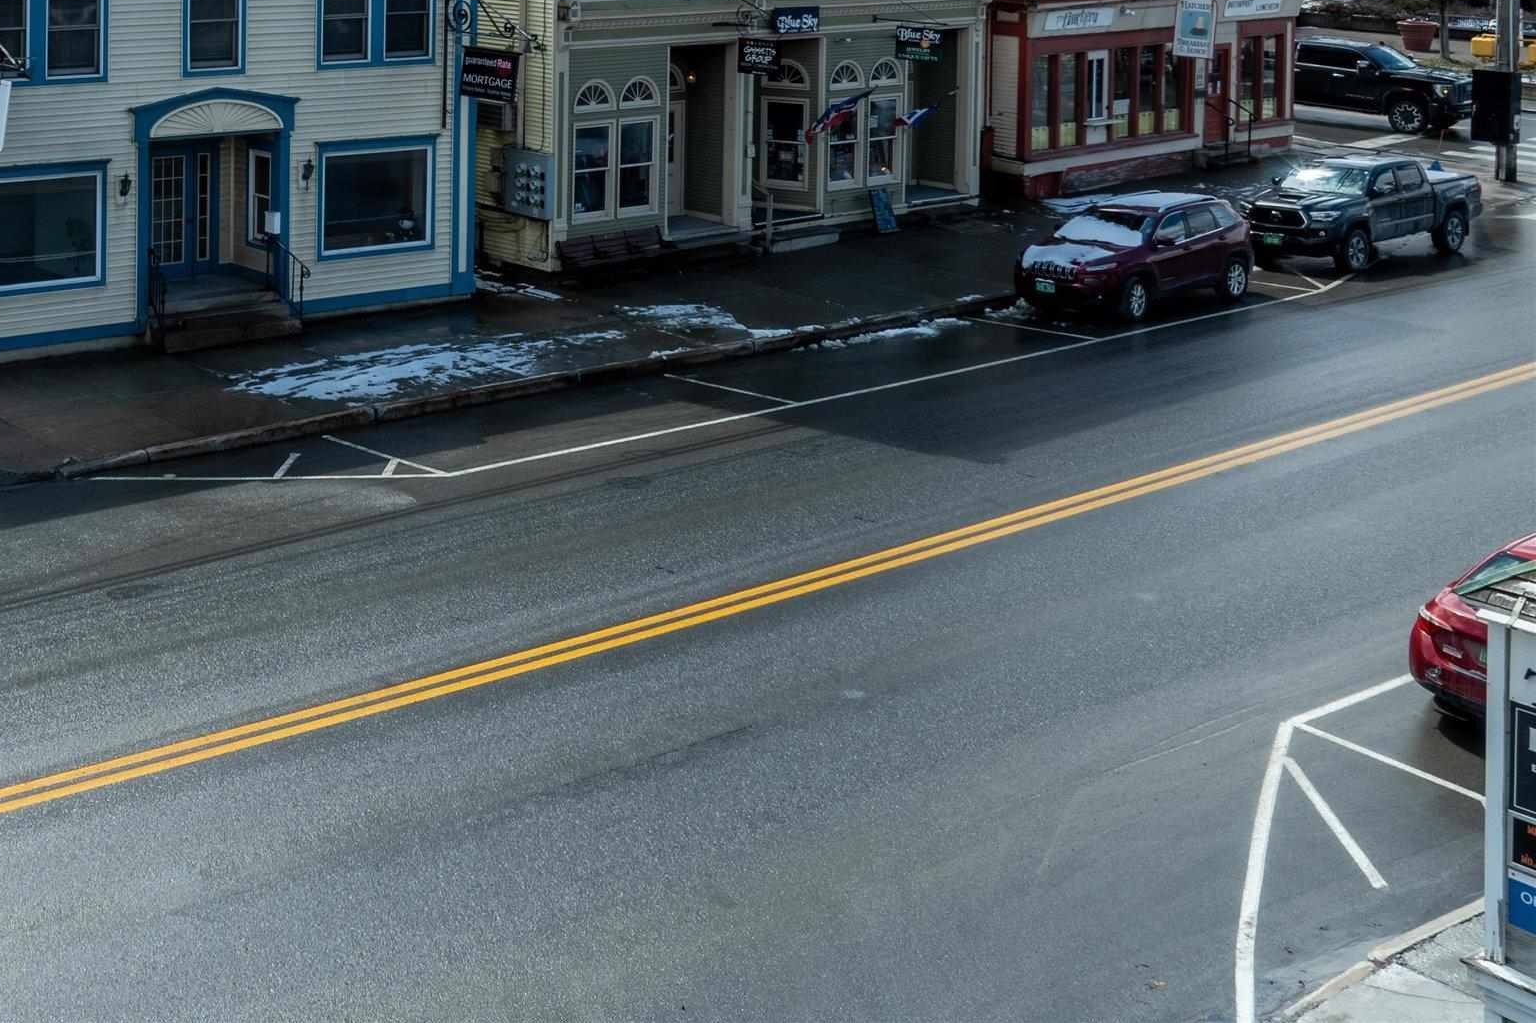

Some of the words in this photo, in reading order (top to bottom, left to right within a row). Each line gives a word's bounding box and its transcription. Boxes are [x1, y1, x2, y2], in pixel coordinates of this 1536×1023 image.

[777, 14, 801, 30] Blue
[801, 12, 818, 32] Sky
[896, 27, 921, 42] Blue
[922, 28, 940, 45] Sky
[462, 72, 514, 90] MORTGAGE
